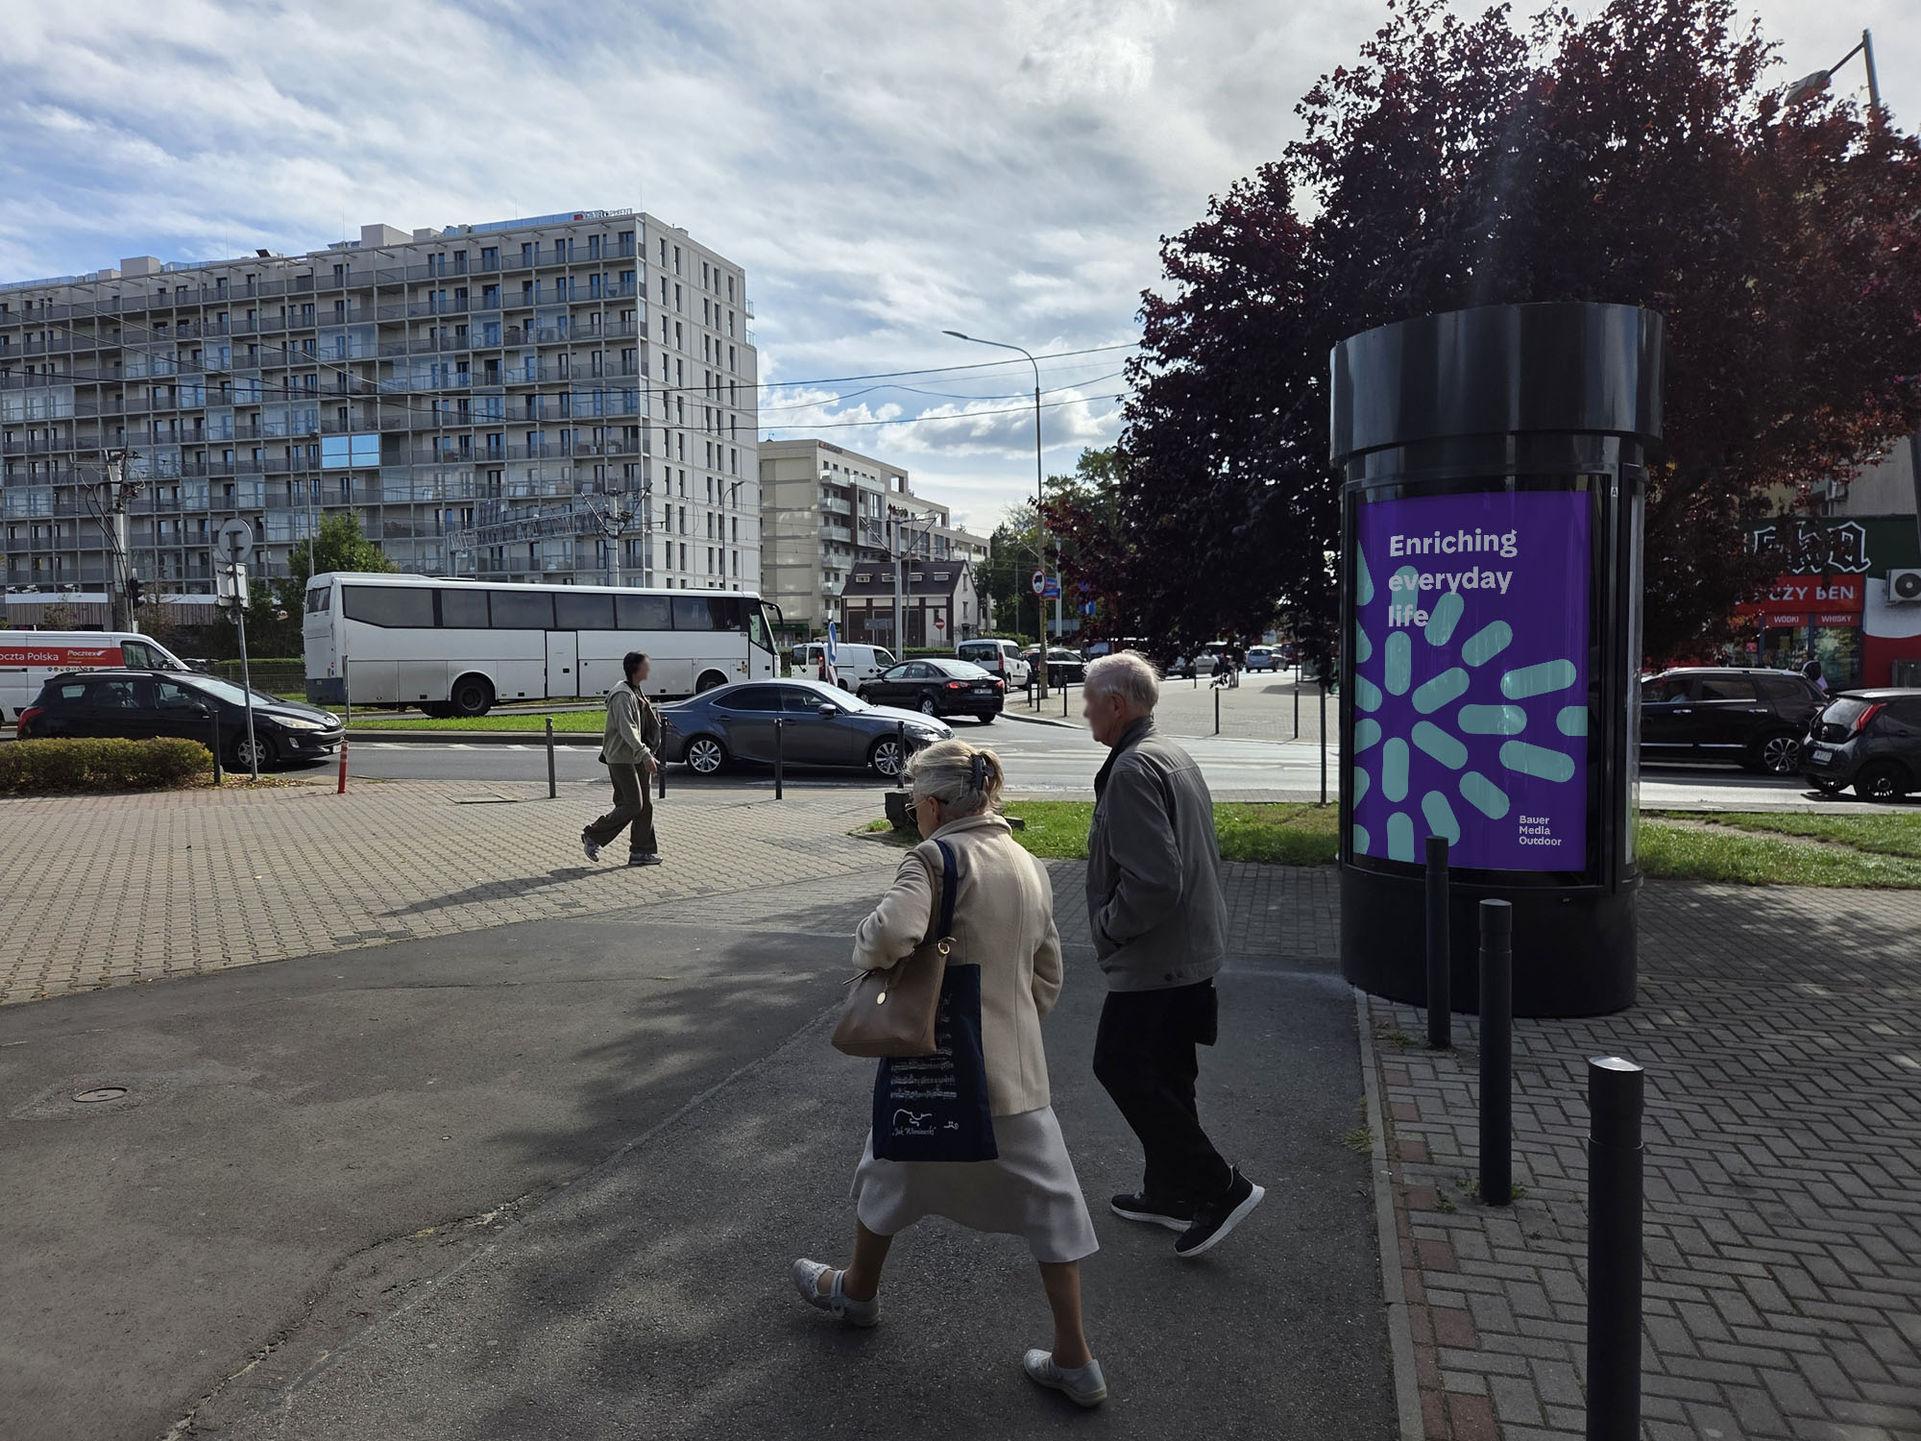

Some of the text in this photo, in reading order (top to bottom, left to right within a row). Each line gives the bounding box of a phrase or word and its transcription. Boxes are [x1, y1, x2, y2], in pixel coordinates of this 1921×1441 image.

[1389, 528, 1518, 558] Enriching
[1388, 566, 1513, 595] everyday
[1816, 586, 1854, 600] BEN
[1388, 604, 1429, 627] life
[1821, 615, 1852, 623] WHISKY
[27, 652, 59, 661] Polska
[1519, 815, 1550, 824] Bauer
[1519, 825, 1551, 835] Media
[1519, 836, 1562, 846] Outdoor
